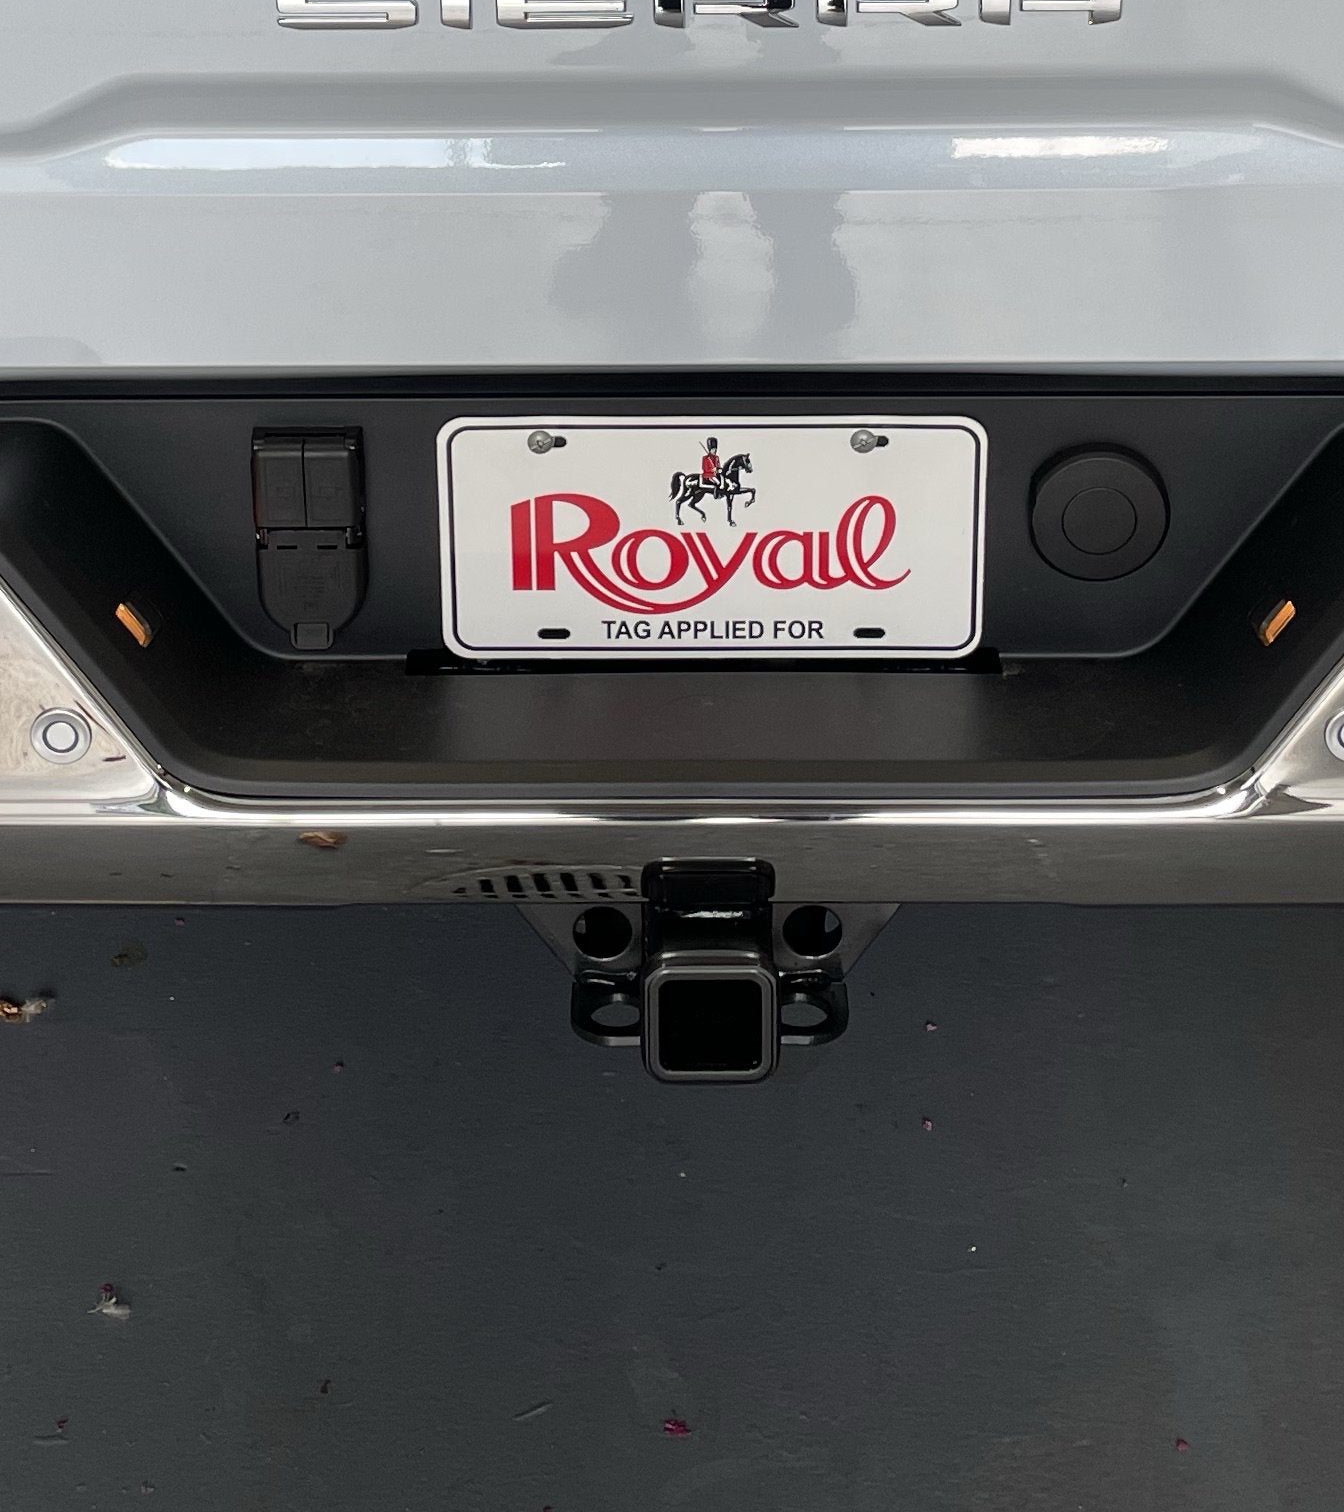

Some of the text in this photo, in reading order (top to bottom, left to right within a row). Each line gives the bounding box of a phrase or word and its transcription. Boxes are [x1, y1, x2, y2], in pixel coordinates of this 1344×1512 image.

[511, 493, 912, 614] Royal
[602, 620, 824, 640] TAG APPLIED FOR
